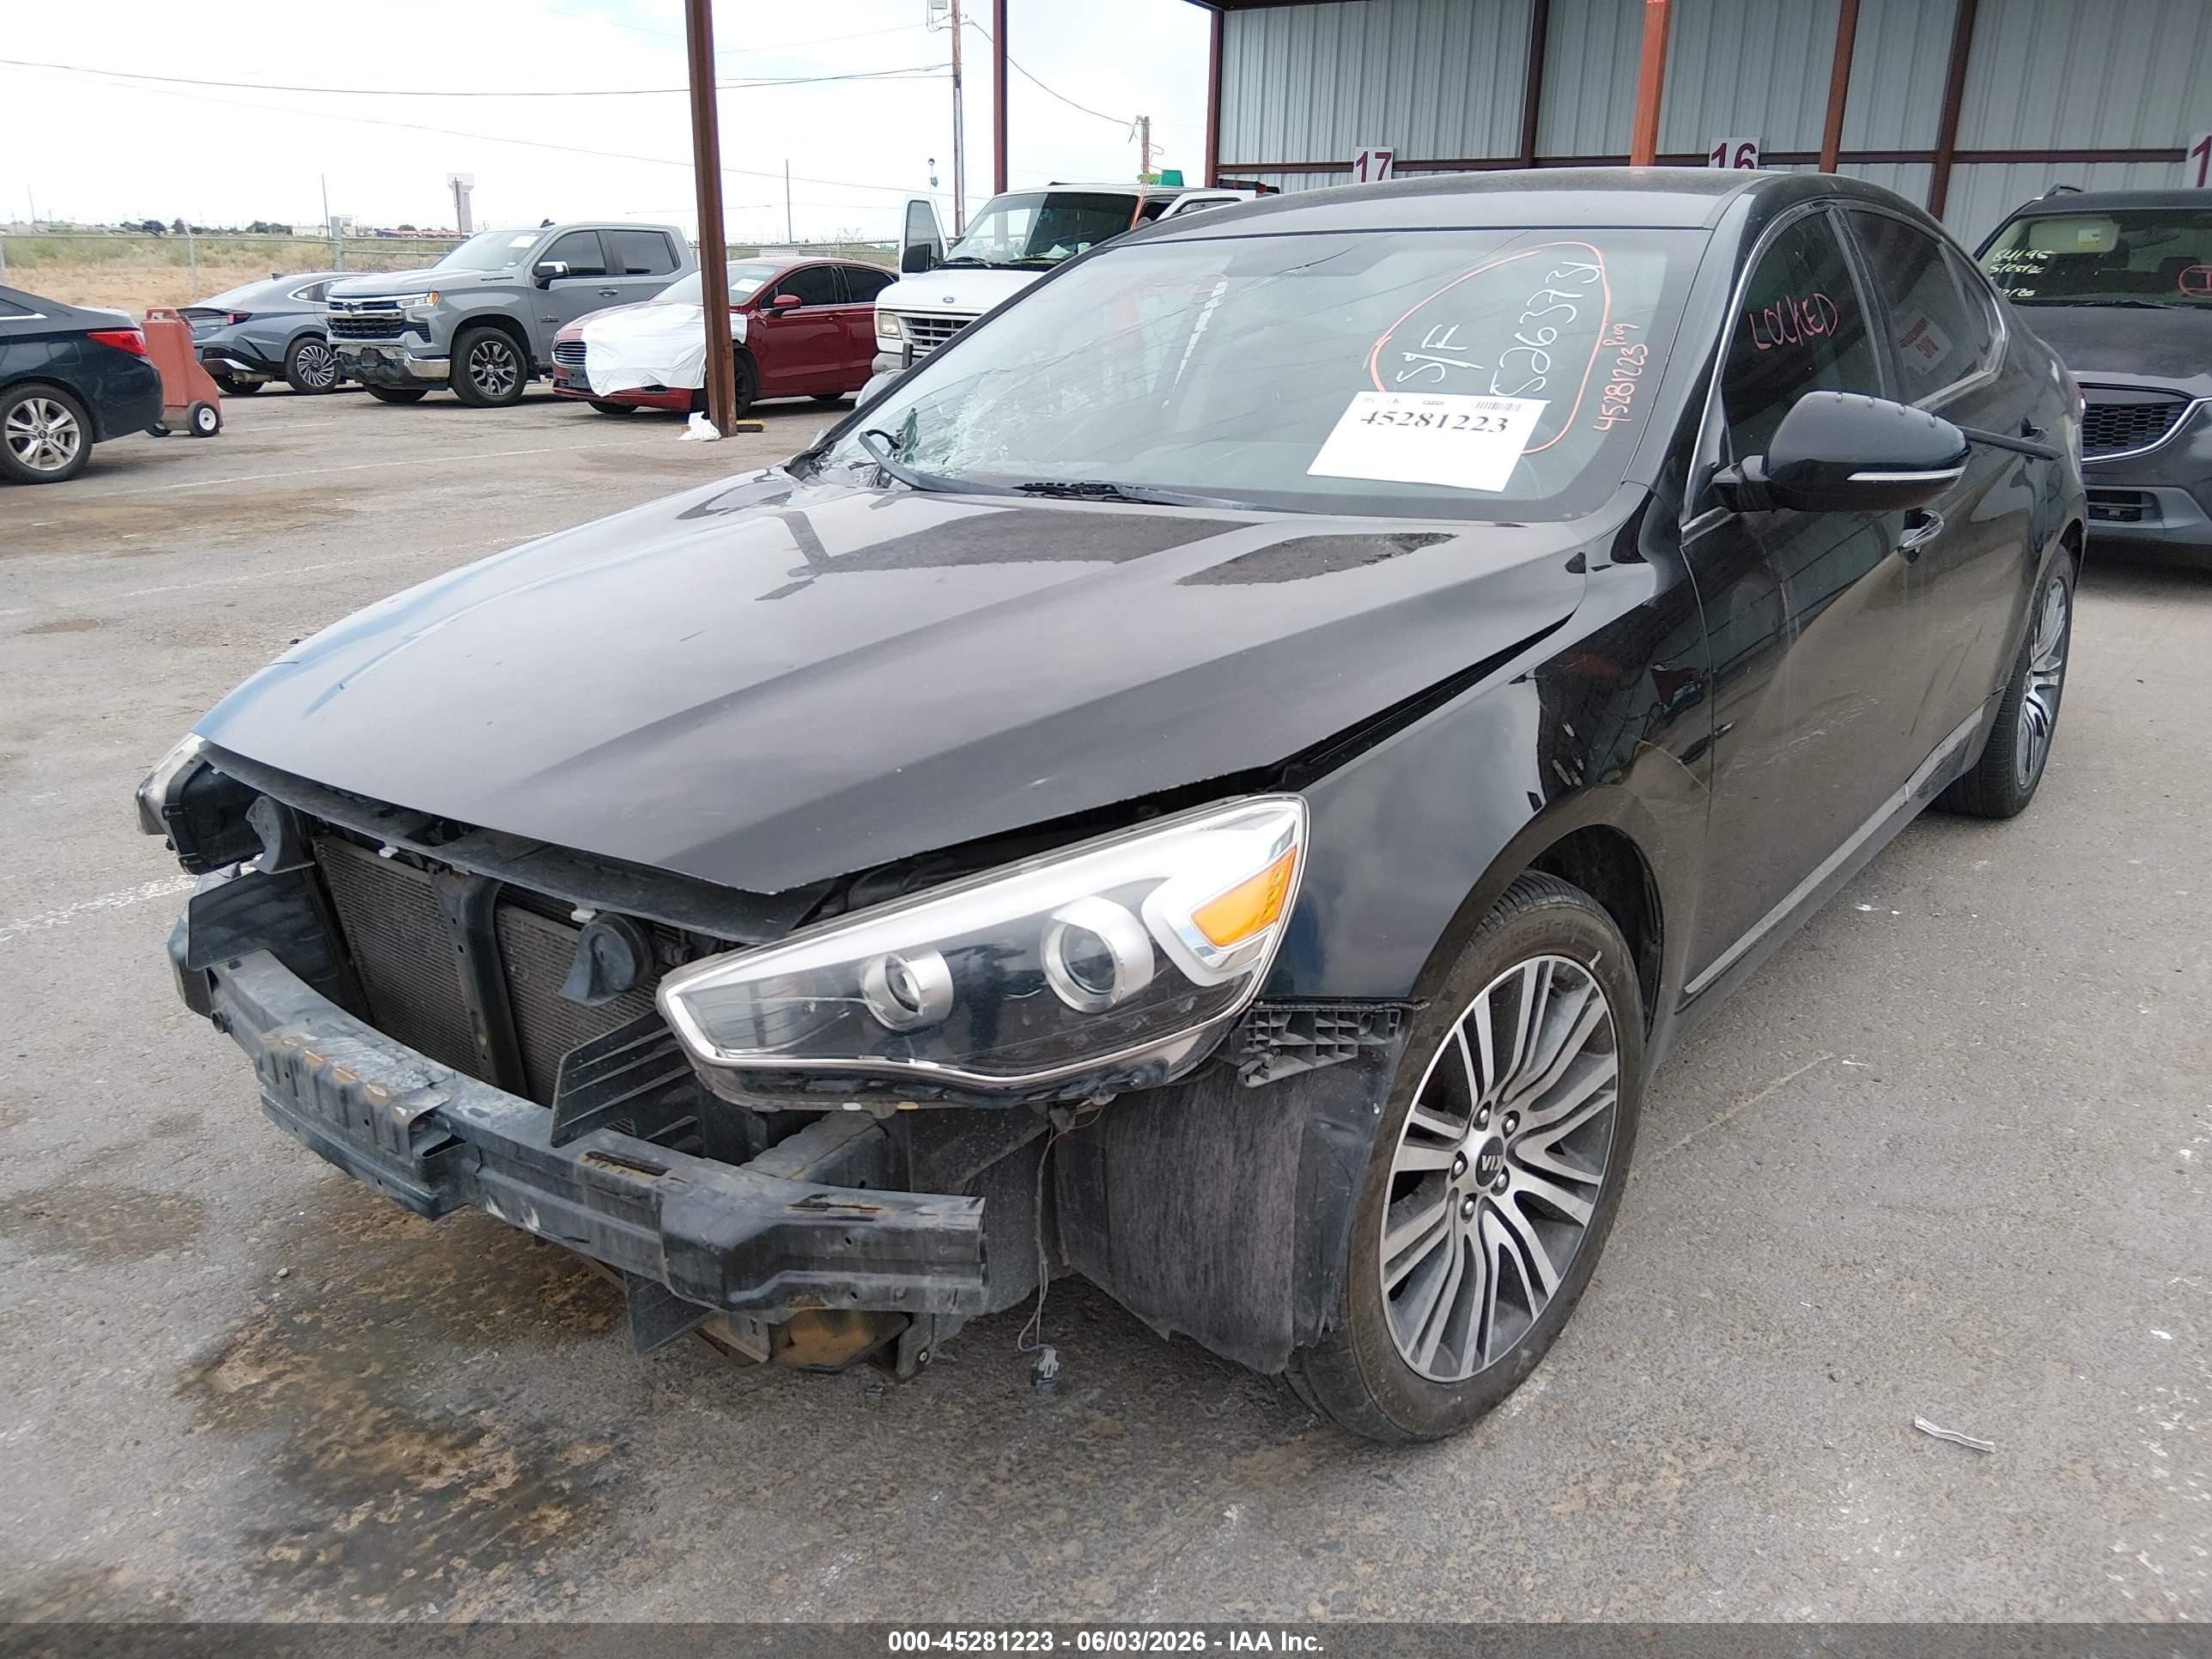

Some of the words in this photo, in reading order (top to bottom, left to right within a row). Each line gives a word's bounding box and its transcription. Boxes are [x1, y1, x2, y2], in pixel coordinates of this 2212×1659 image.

[1356, 151, 1392, 183] 17
[1711, 143, 1756, 169] 16
[1594, 343, 1650, 431] 45281223
[1360, 410, 1509, 434] 45281223
